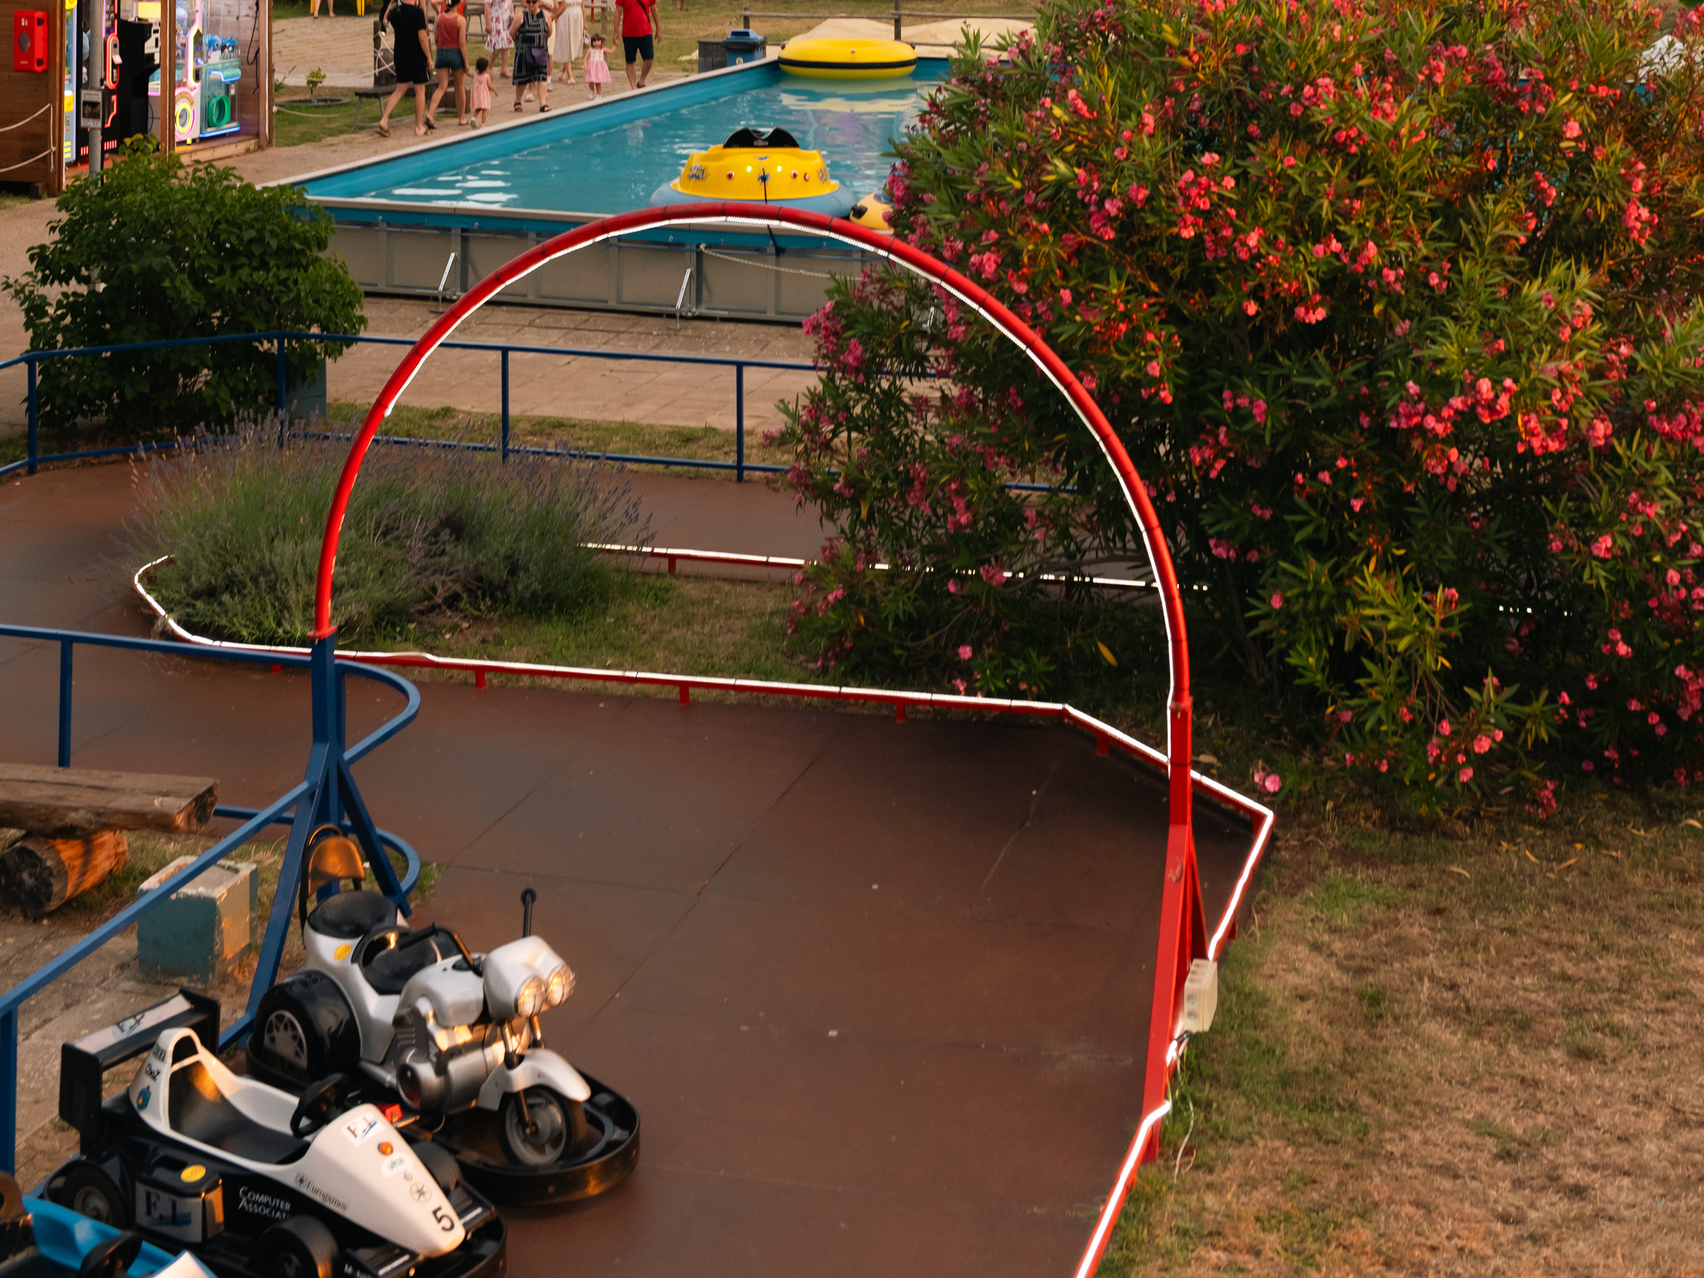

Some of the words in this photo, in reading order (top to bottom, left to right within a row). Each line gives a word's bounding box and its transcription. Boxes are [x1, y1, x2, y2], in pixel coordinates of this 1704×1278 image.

[238, 1198, 290, 1220] ASSOCIAT
[239, 1186, 291, 1212] COMPUTER
[432, 1206, 455, 1232] 5
